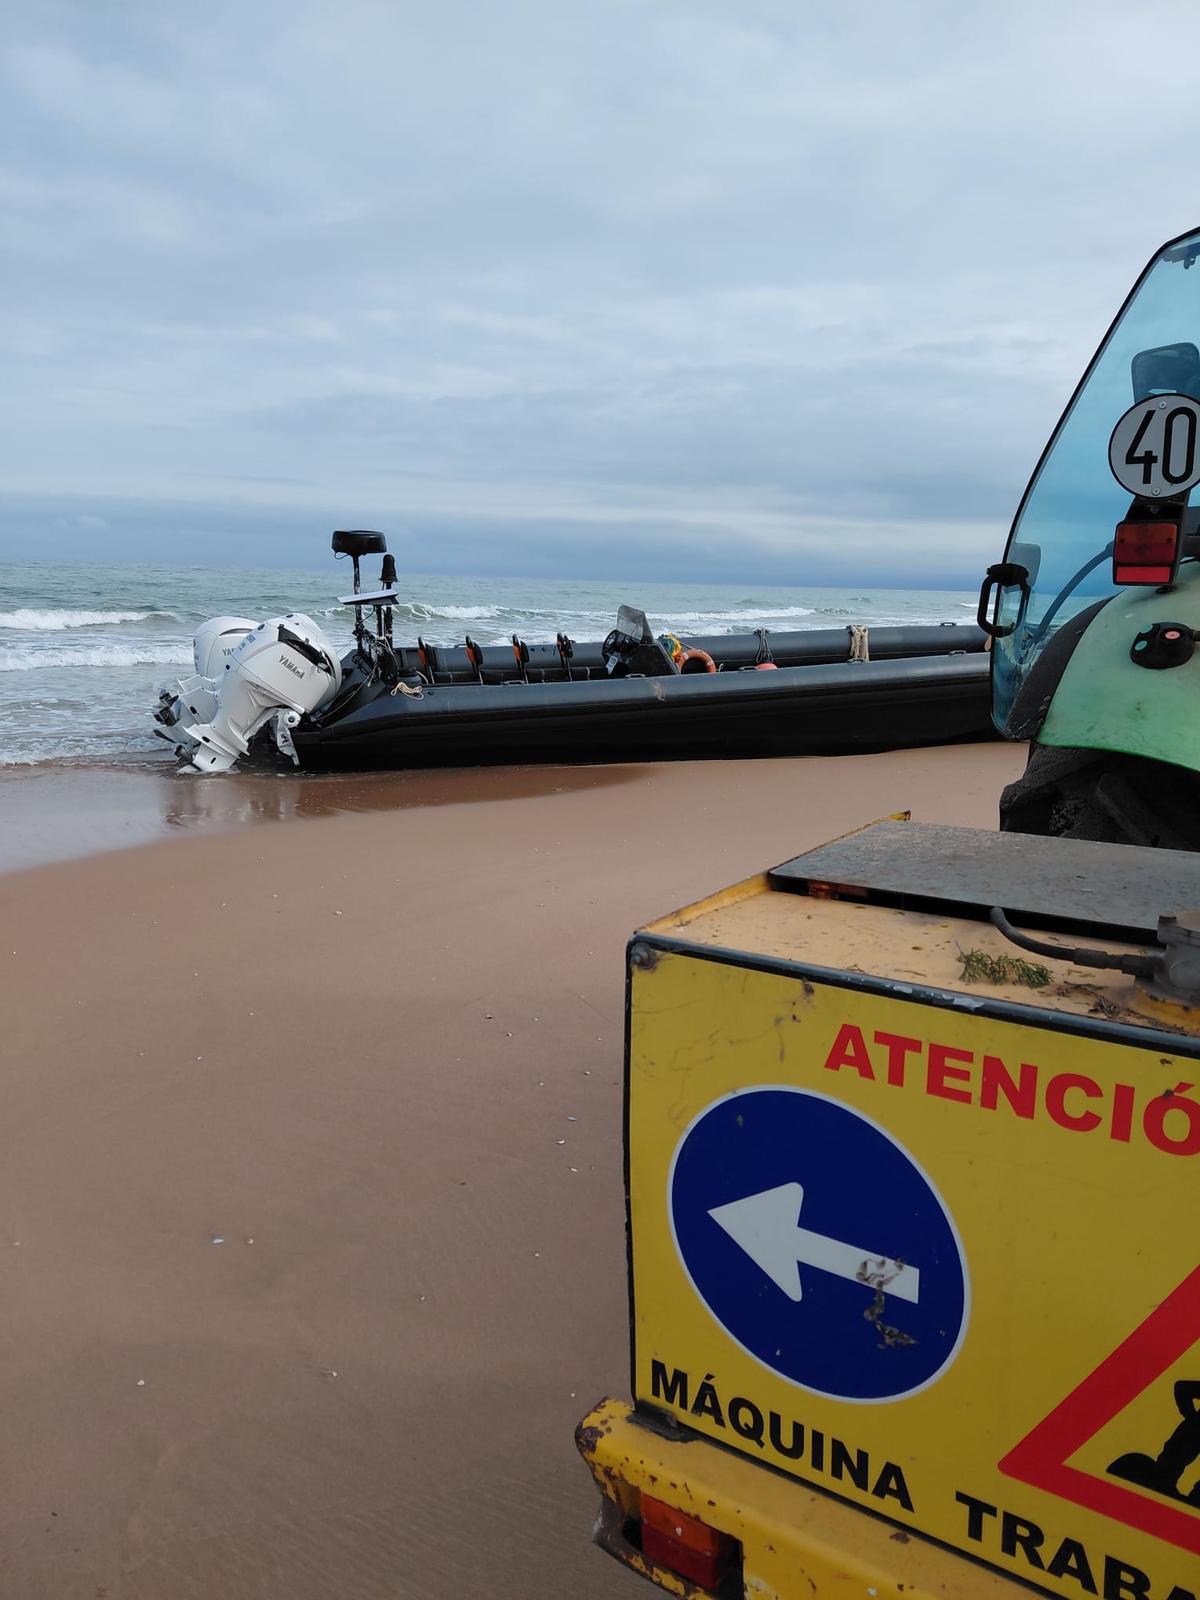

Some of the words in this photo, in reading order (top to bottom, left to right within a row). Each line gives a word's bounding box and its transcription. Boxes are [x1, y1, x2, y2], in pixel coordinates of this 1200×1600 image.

[1125, 406, 1197, 484] 40
[279, 655, 305, 680] YAMAHA
[651, 1359, 914, 1512] MÁQUINA
[955, 1491, 1200, 1600] TRAB
